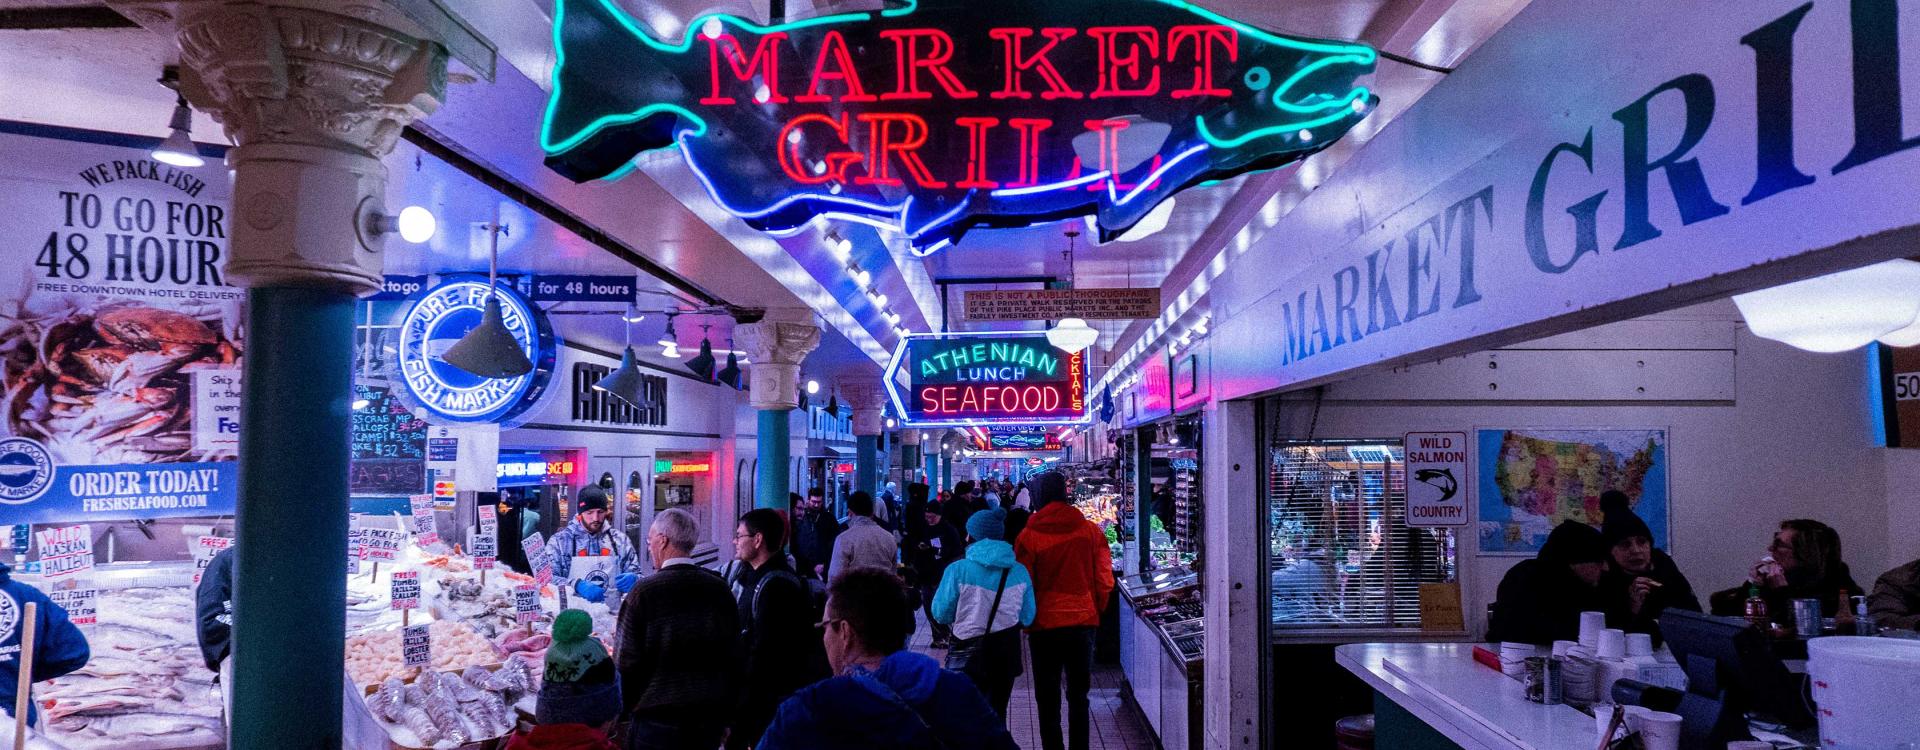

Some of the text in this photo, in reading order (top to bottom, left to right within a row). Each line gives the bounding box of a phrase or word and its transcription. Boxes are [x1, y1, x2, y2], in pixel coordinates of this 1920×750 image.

[698, 25, 1238, 106] MARKET
[778, 112, 1164, 192] GRILL
[79, 159, 206, 197] WE PACK FISH
[59, 191, 226, 238] TO GO FOR
[35, 231, 230, 287] 48 HOUR
[1281, 185, 1494, 367] MARKET
[36, 283, 67, 293] FREE
[71, 284, 146, 296] DOWNTOWN
[150, 289, 186, 298] HOTEL
[388, 282, 401, 291] to
[402, 283, 420, 294] go
[538, 282, 629, 294] for 48 hours
[1037, 291, 1070, 299] PUBLIC
[920, 342, 1057, 378] ATHENIAN
[956, 367, 1026, 381] LUNCH
[211, 375, 233, 389] Ship
[406, 359, 515, 409] FISH MARK
[1071, 352, 1083, 411] CKTAILS
[209, 388, 220, 397] in
[922, 386, 1059, 413] SEAFOOD
[396, 415, 411, 423] MP
[353, 424, 389, 433] ALLOPS
[1420, 438, 1451, 449] WILD
[19, 442, 45, 465] FOOD
[1409, 452, 1464, 463] SALMON
[8, 468, 46, 496] MARKET
[69, 469, 219, 496] ORDER TODAY!
[83, 494, 208, 512] FRESHSEAFOOD.COM
[1412, 506, 1463, 518] COUNTRY
[43, 526, 81, 546] WILD
[371, 529, 388, 538] PACK
[40, 540, 86, 557] ALASKAN
[45, 553, 93, 574] HALIBUT
[392, 579, 418, 587] JUMBO
[69, 590, 95, 600] FILLET
[392, 592, 421, 600] SCALLOPS
[516, 591, 535, 600] MONK
[517, 598, 534, 606] FISH
[403, 645, 430, 656] LOBSTER
